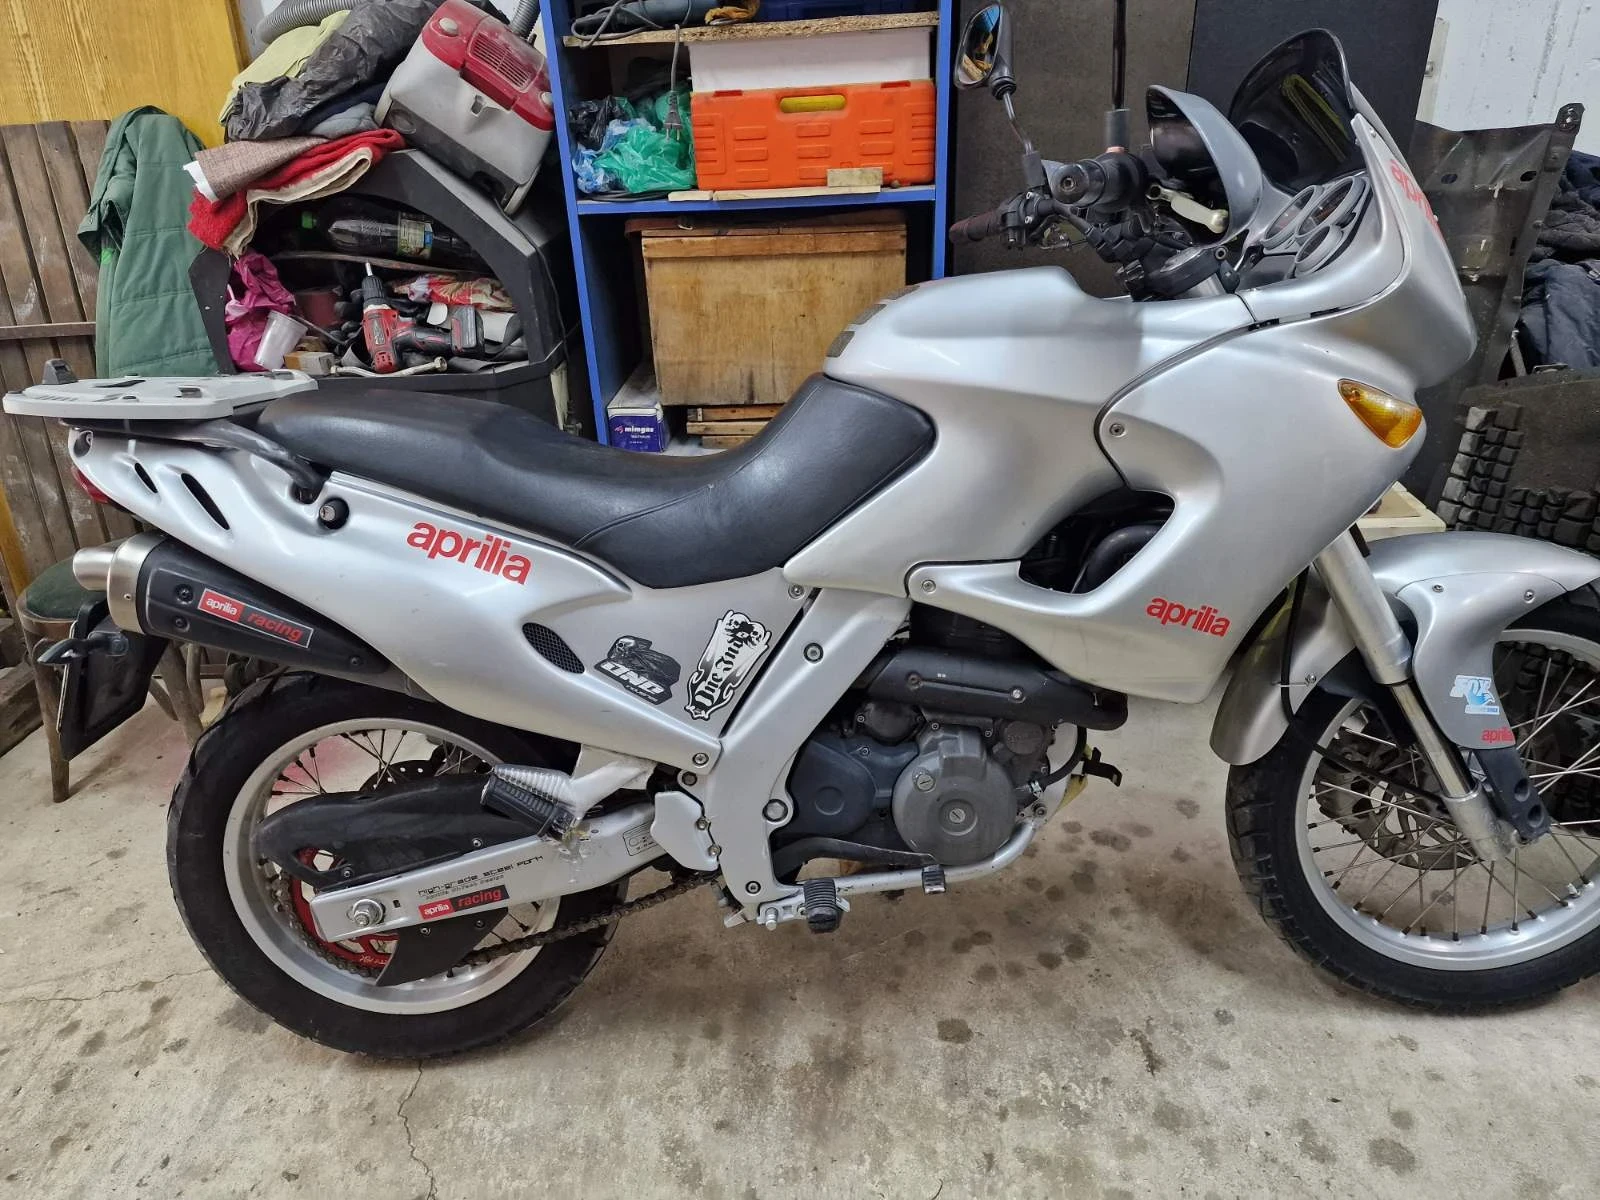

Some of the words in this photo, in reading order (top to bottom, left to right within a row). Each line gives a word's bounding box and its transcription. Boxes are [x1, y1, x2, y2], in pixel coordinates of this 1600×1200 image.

[406, 522, 532, 585] aprilia
[206, 598, 238, 616] aprilia
[247, 613, 303, 641] racing
[1146, 597, 1230, 637] aprilia
[424, 902, 449, 917] aprilia
[458, 887, 502, 907] racing
